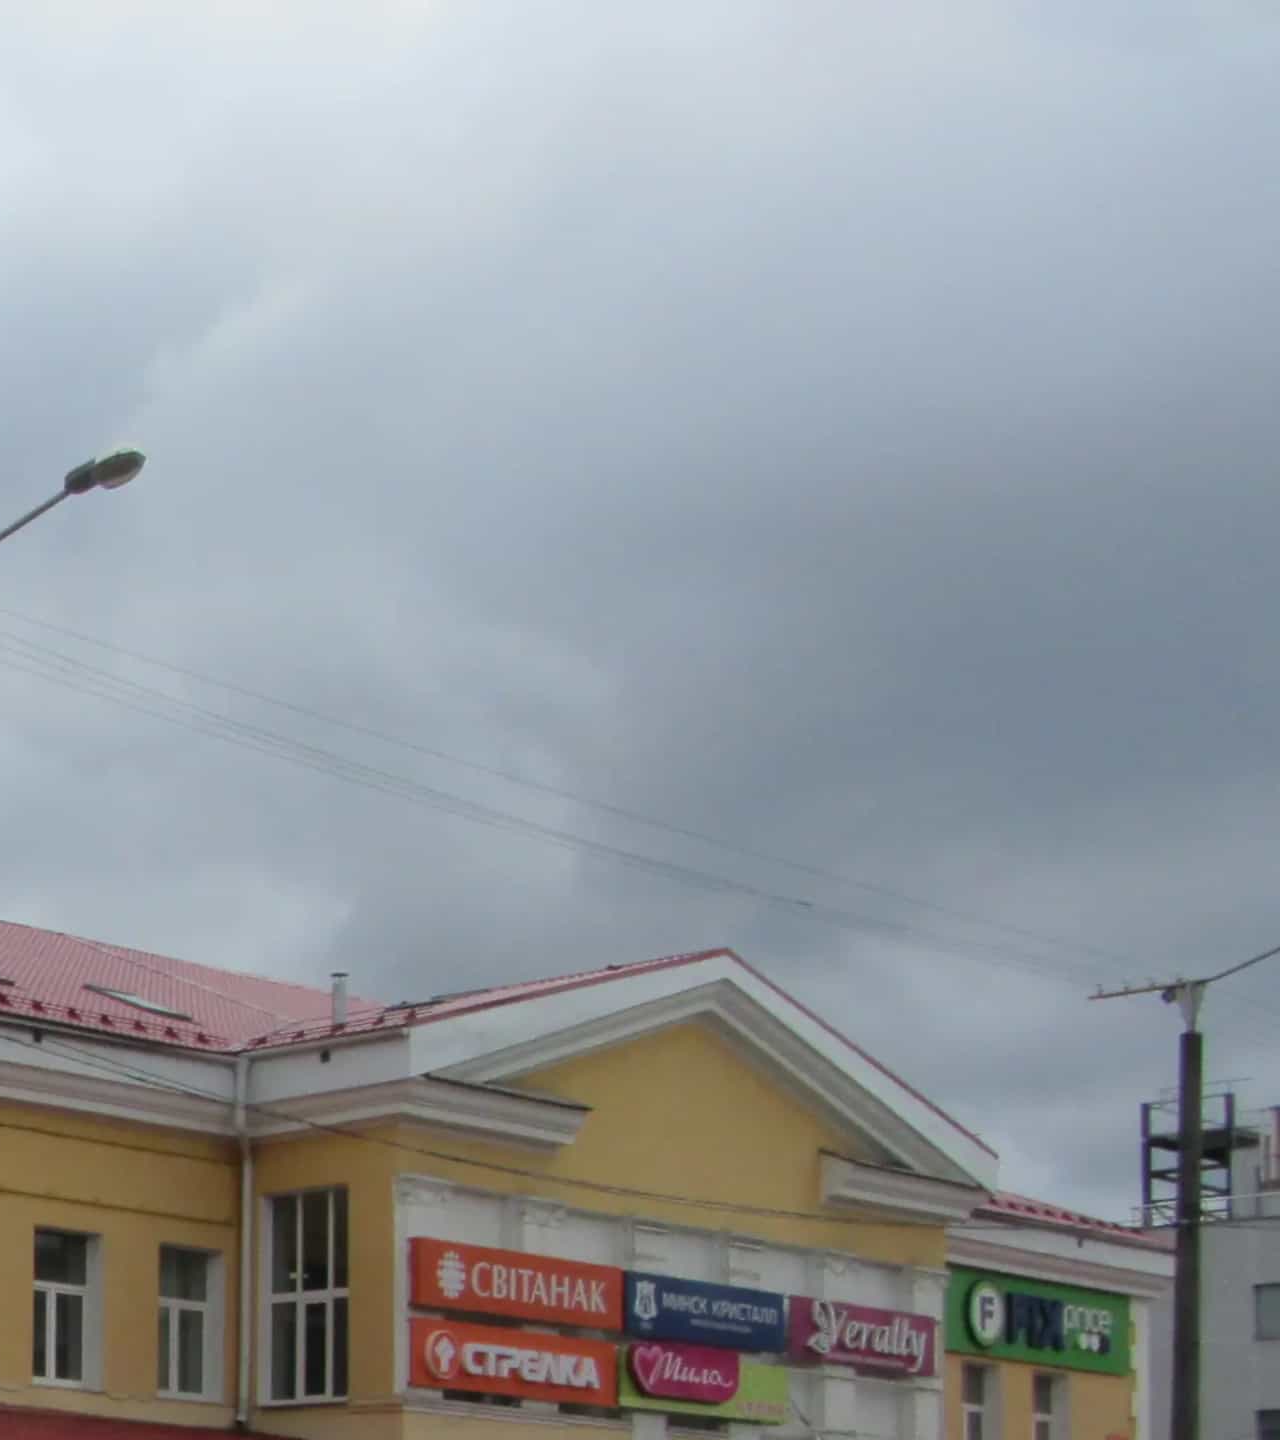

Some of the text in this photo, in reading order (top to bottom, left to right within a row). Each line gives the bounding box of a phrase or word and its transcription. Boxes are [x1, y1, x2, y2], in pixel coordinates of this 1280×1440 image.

[471, 1261, 607, 1315] СВІТАНАК
[662, 1291, 708, 1315] МИНСК
[711, 1300, 779, 1326] КРИСТАЛЛ
[461, 1342, 601, 1390] СТРЕЛКА
[649, 1350, 734, 1388] Мила
